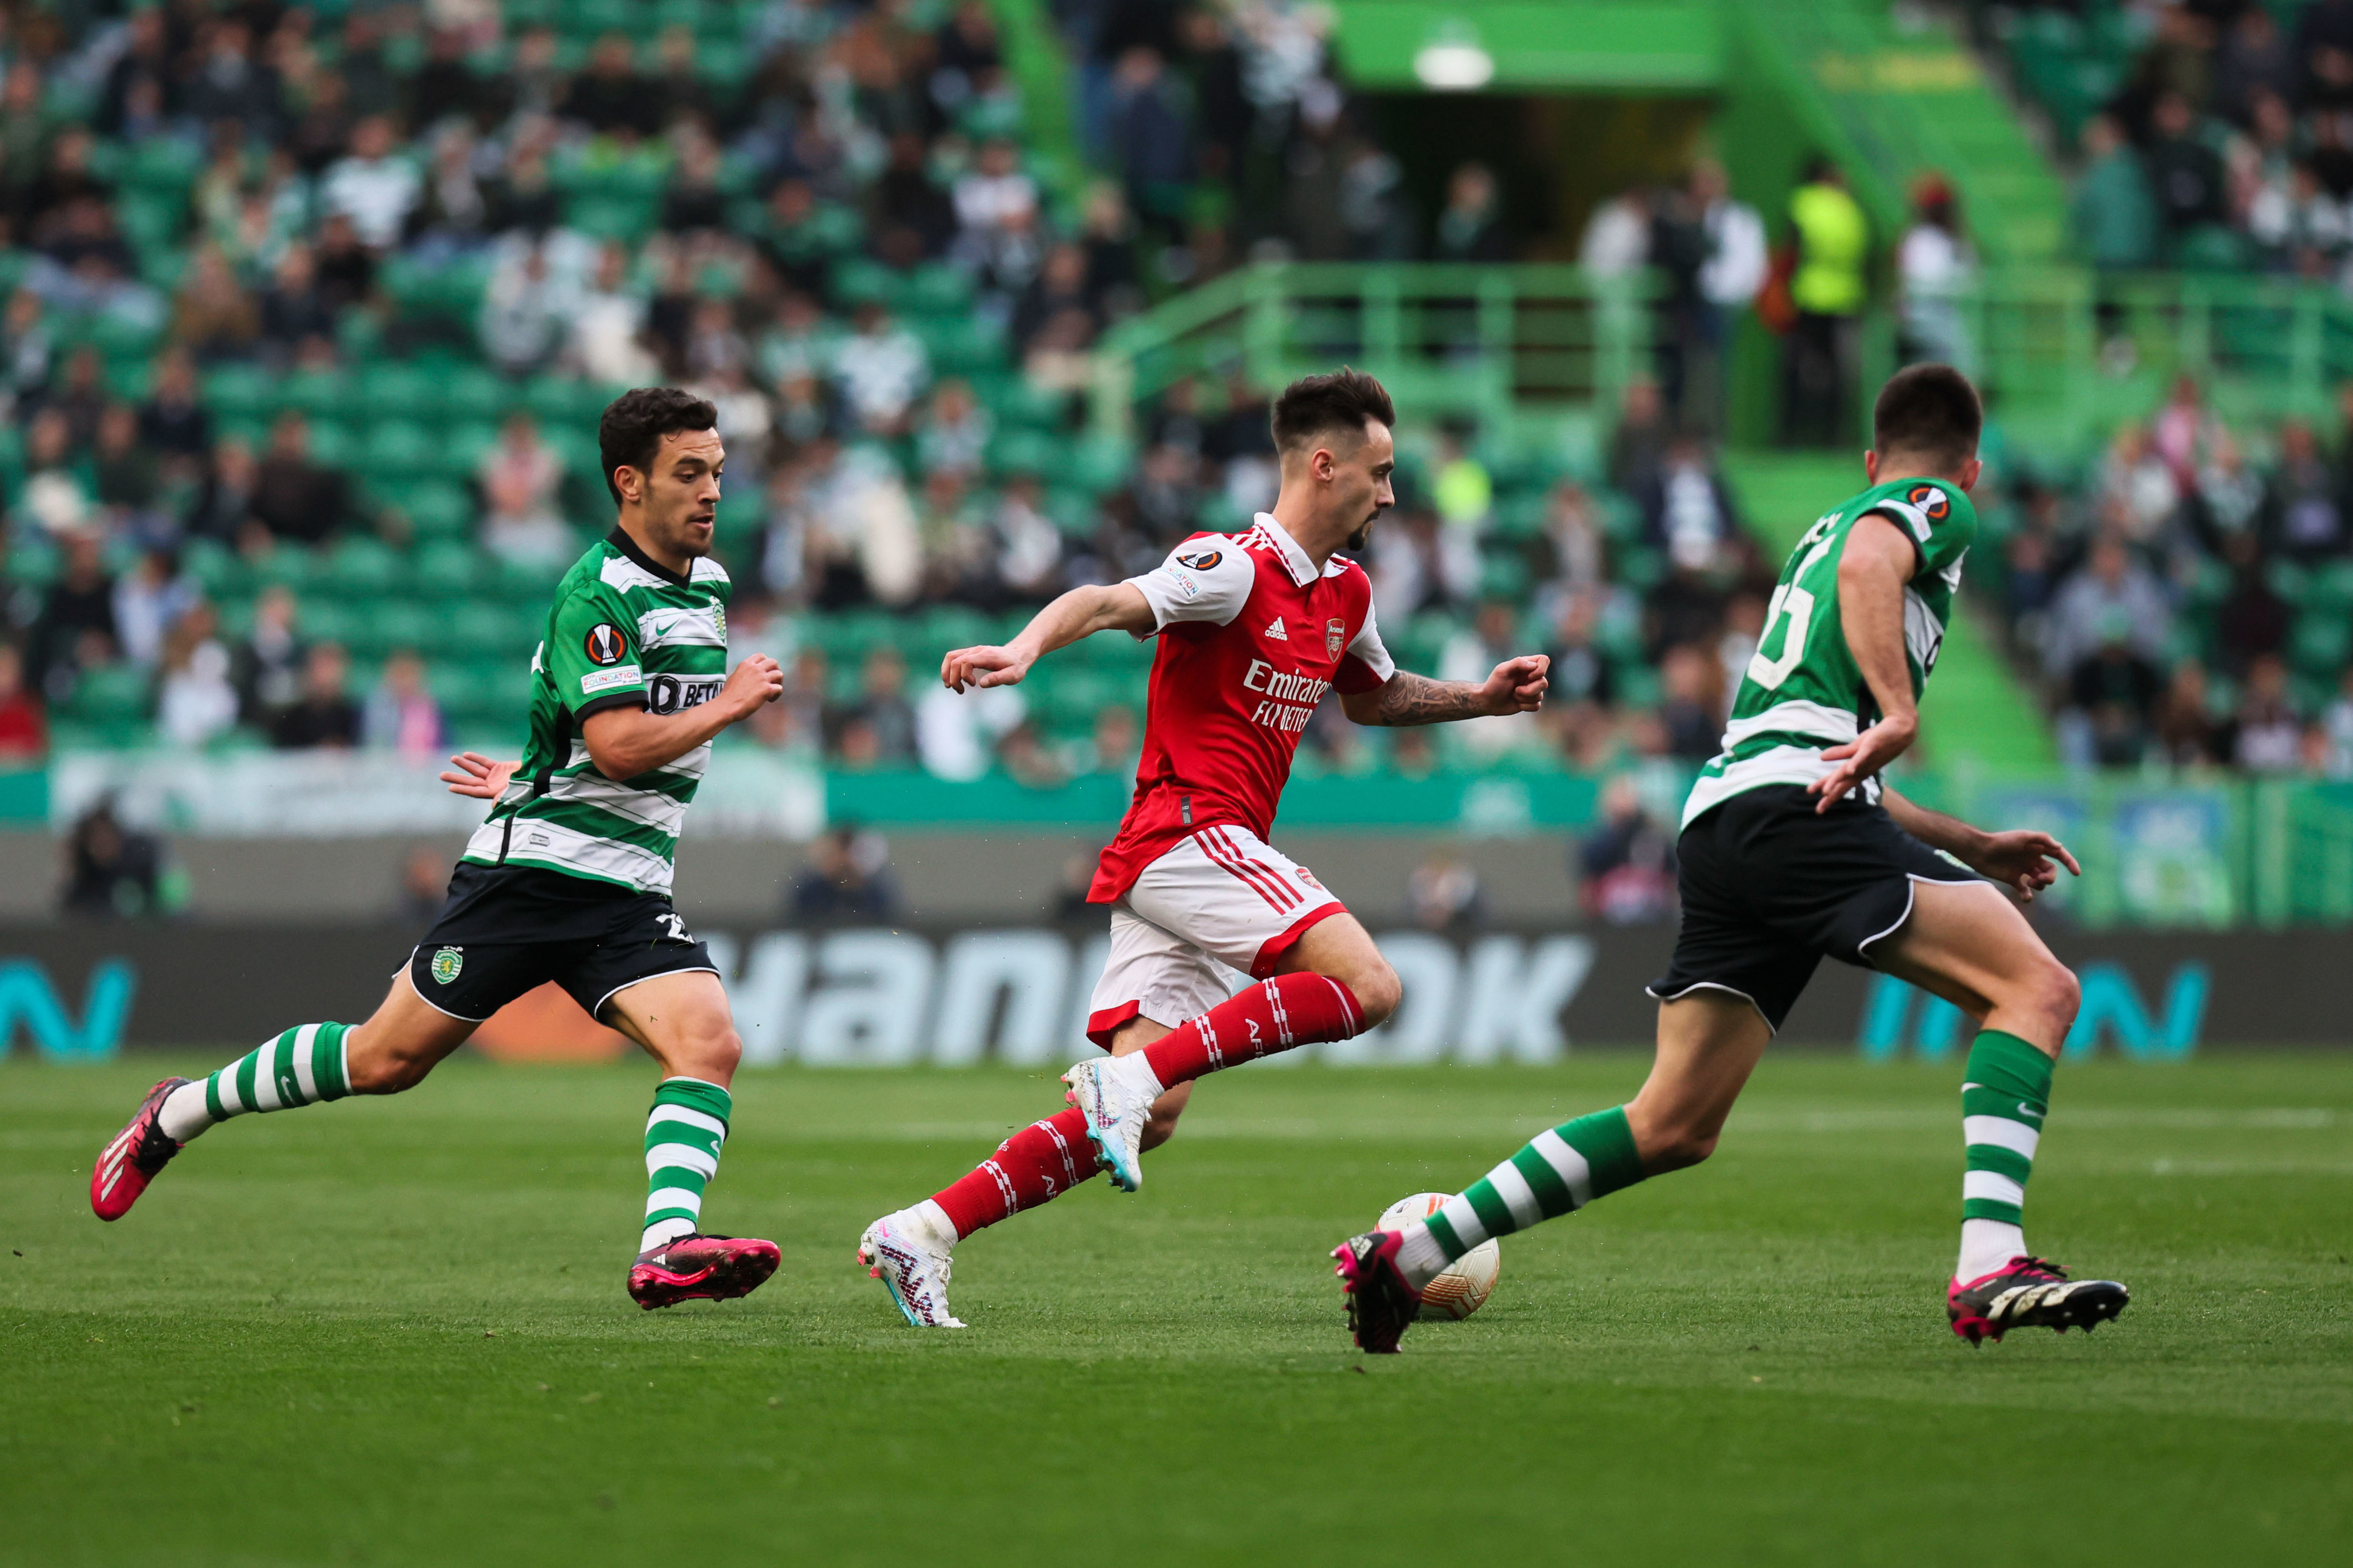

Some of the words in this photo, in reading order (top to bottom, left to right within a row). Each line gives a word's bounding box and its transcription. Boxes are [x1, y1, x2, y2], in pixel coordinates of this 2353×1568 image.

[1265, 629, 1288, 641] adidas
[584, 671, 639, 688] FOUNDATION
[1251, 700, 1282, 728] FLY
